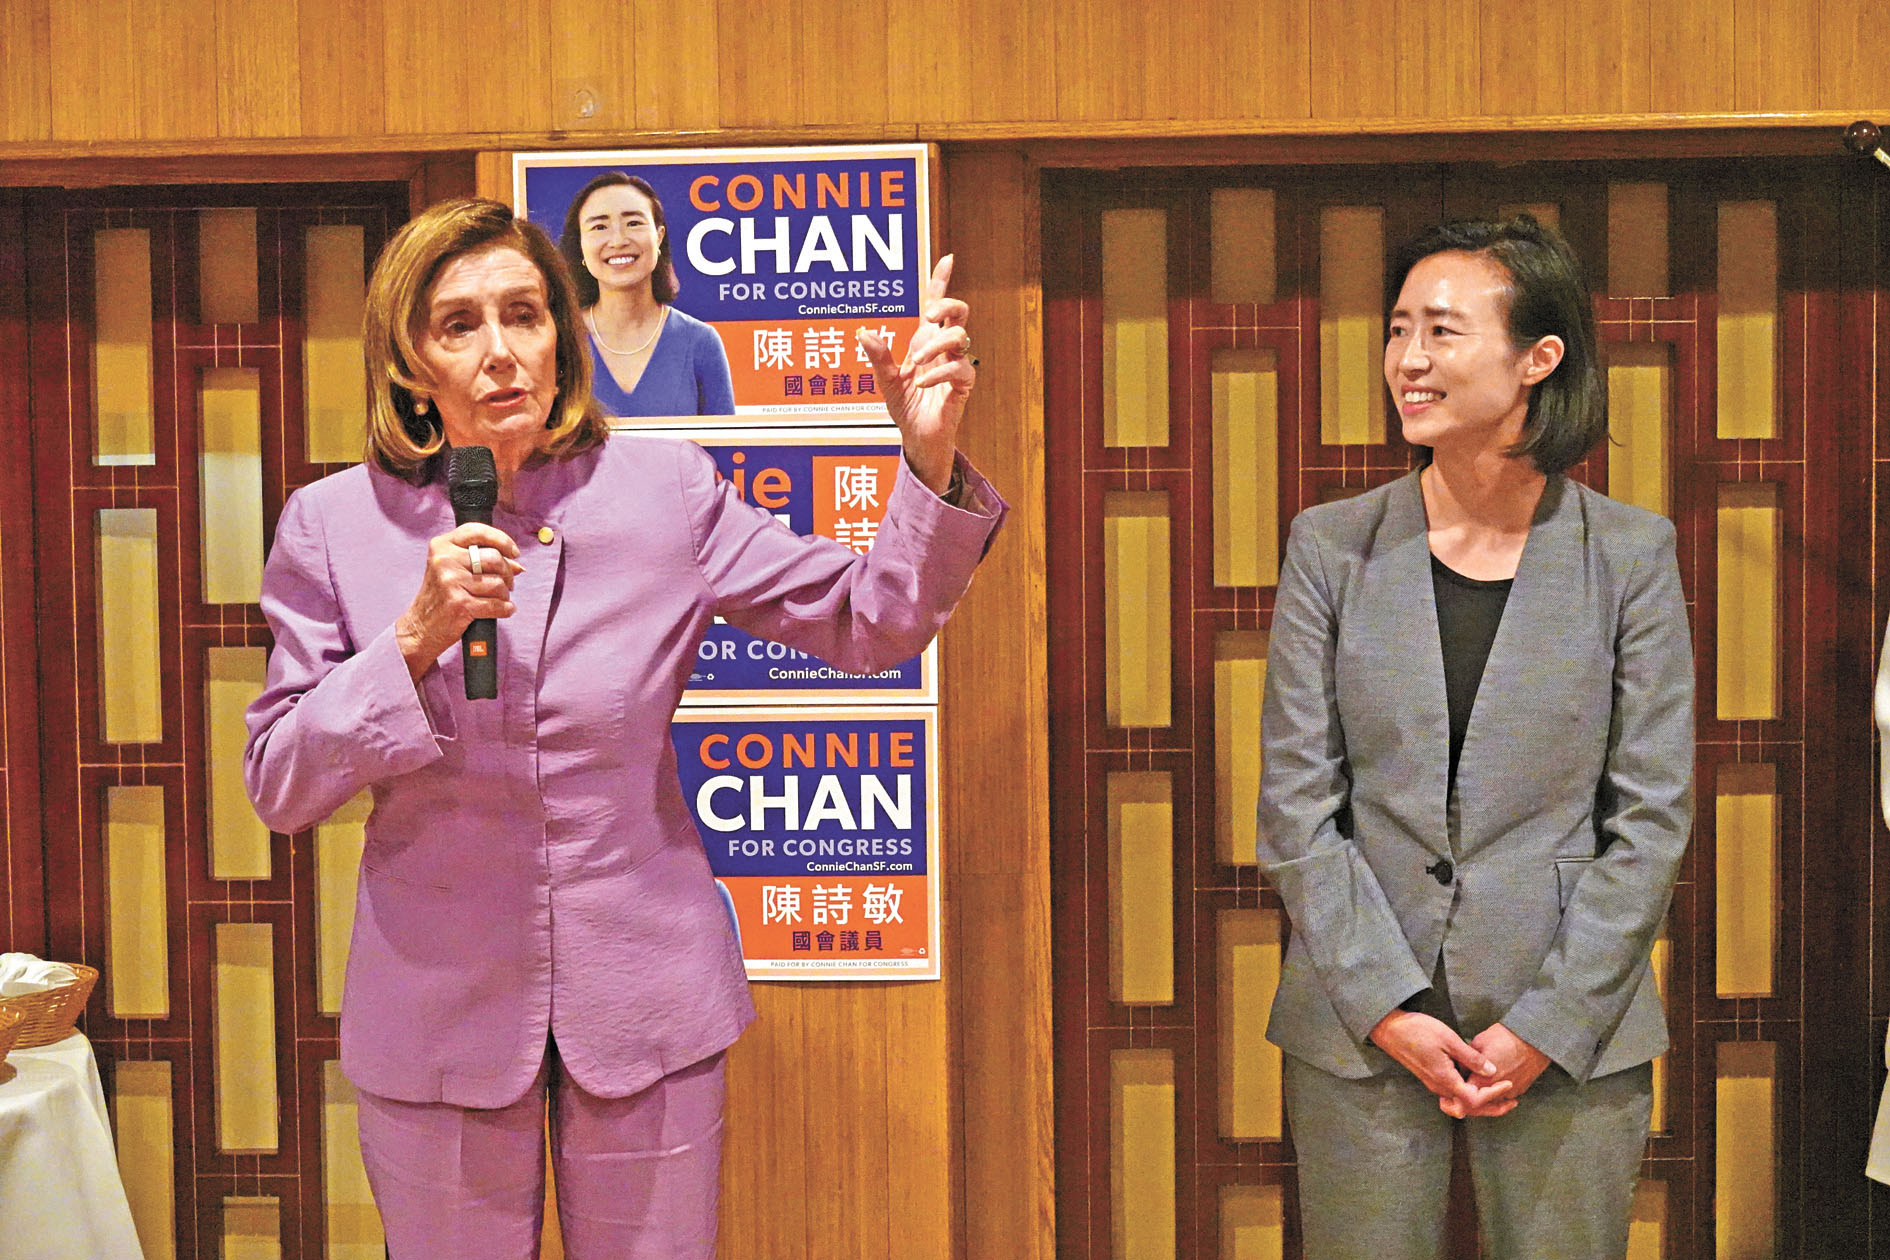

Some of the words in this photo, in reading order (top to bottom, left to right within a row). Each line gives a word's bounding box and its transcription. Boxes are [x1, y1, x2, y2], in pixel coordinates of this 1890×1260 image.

[689, 171, 905, 212] CONNIE
[686, 213, 904, 277] CHAN
[719, 283, 766, 301] FOR
[774, 279, 905, 300] CONGRESS
[798, 303, 905, 316] ConnieChanSF.com
[784, 374, 876, 396] 國會議員
[698, 640, 736, 660] OR
[699, 732, 914, 770] CONNIE
[696, 774, 912, 832] CHAN
[728, 839, 775, 857] FOR
[783, 838, 913, 856] CONGRESS
[807, 861, 913, 873] ConnieChanSF.com
[762, 883, 904, 926] 陳詩敏
[792, 930, 883, 952] 國會議員
